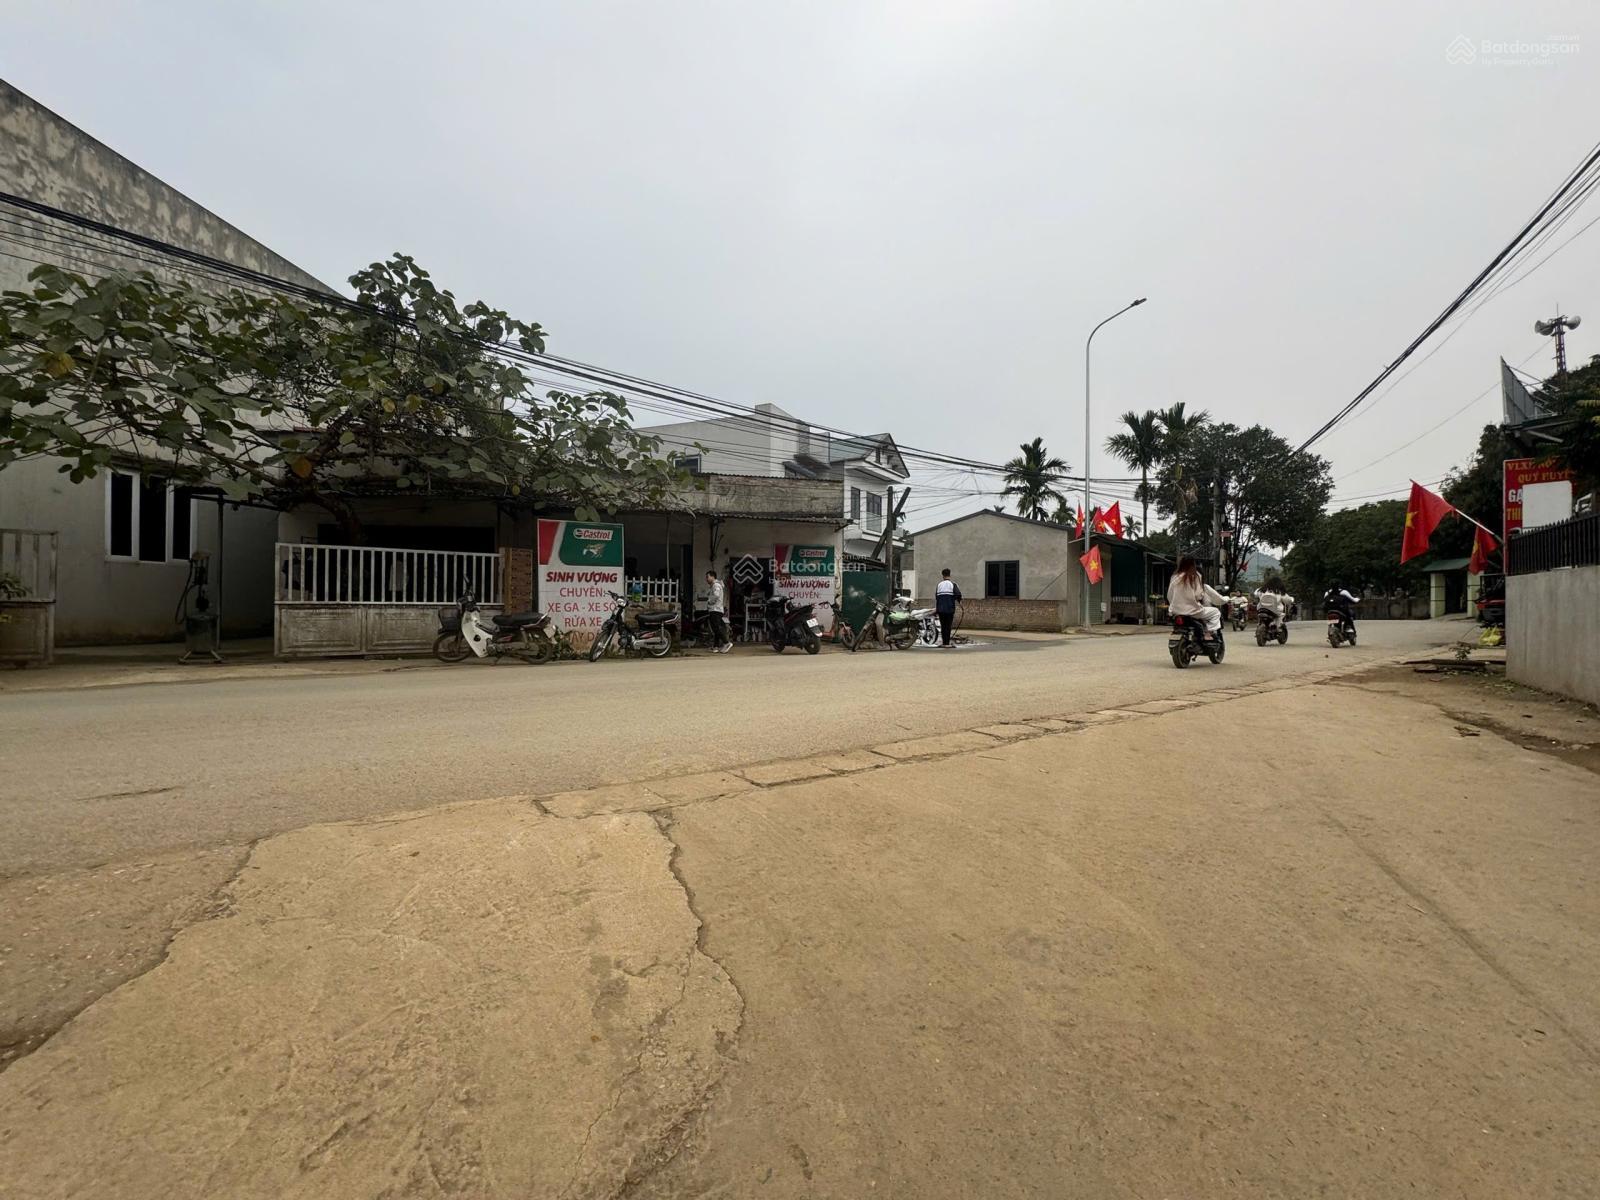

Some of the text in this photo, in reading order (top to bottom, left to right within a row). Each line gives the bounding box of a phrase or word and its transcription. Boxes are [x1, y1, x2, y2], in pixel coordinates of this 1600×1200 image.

[583, 529, 611, 540] Castrol
[546, 570, 618, 586] SINH VƯỢNG
[547, 602, 561, 613] XE
[563, 602, 579, 613] GA
[588, 602, 600, 612] XE
[564, 614, 602, 627] RỬA XE
